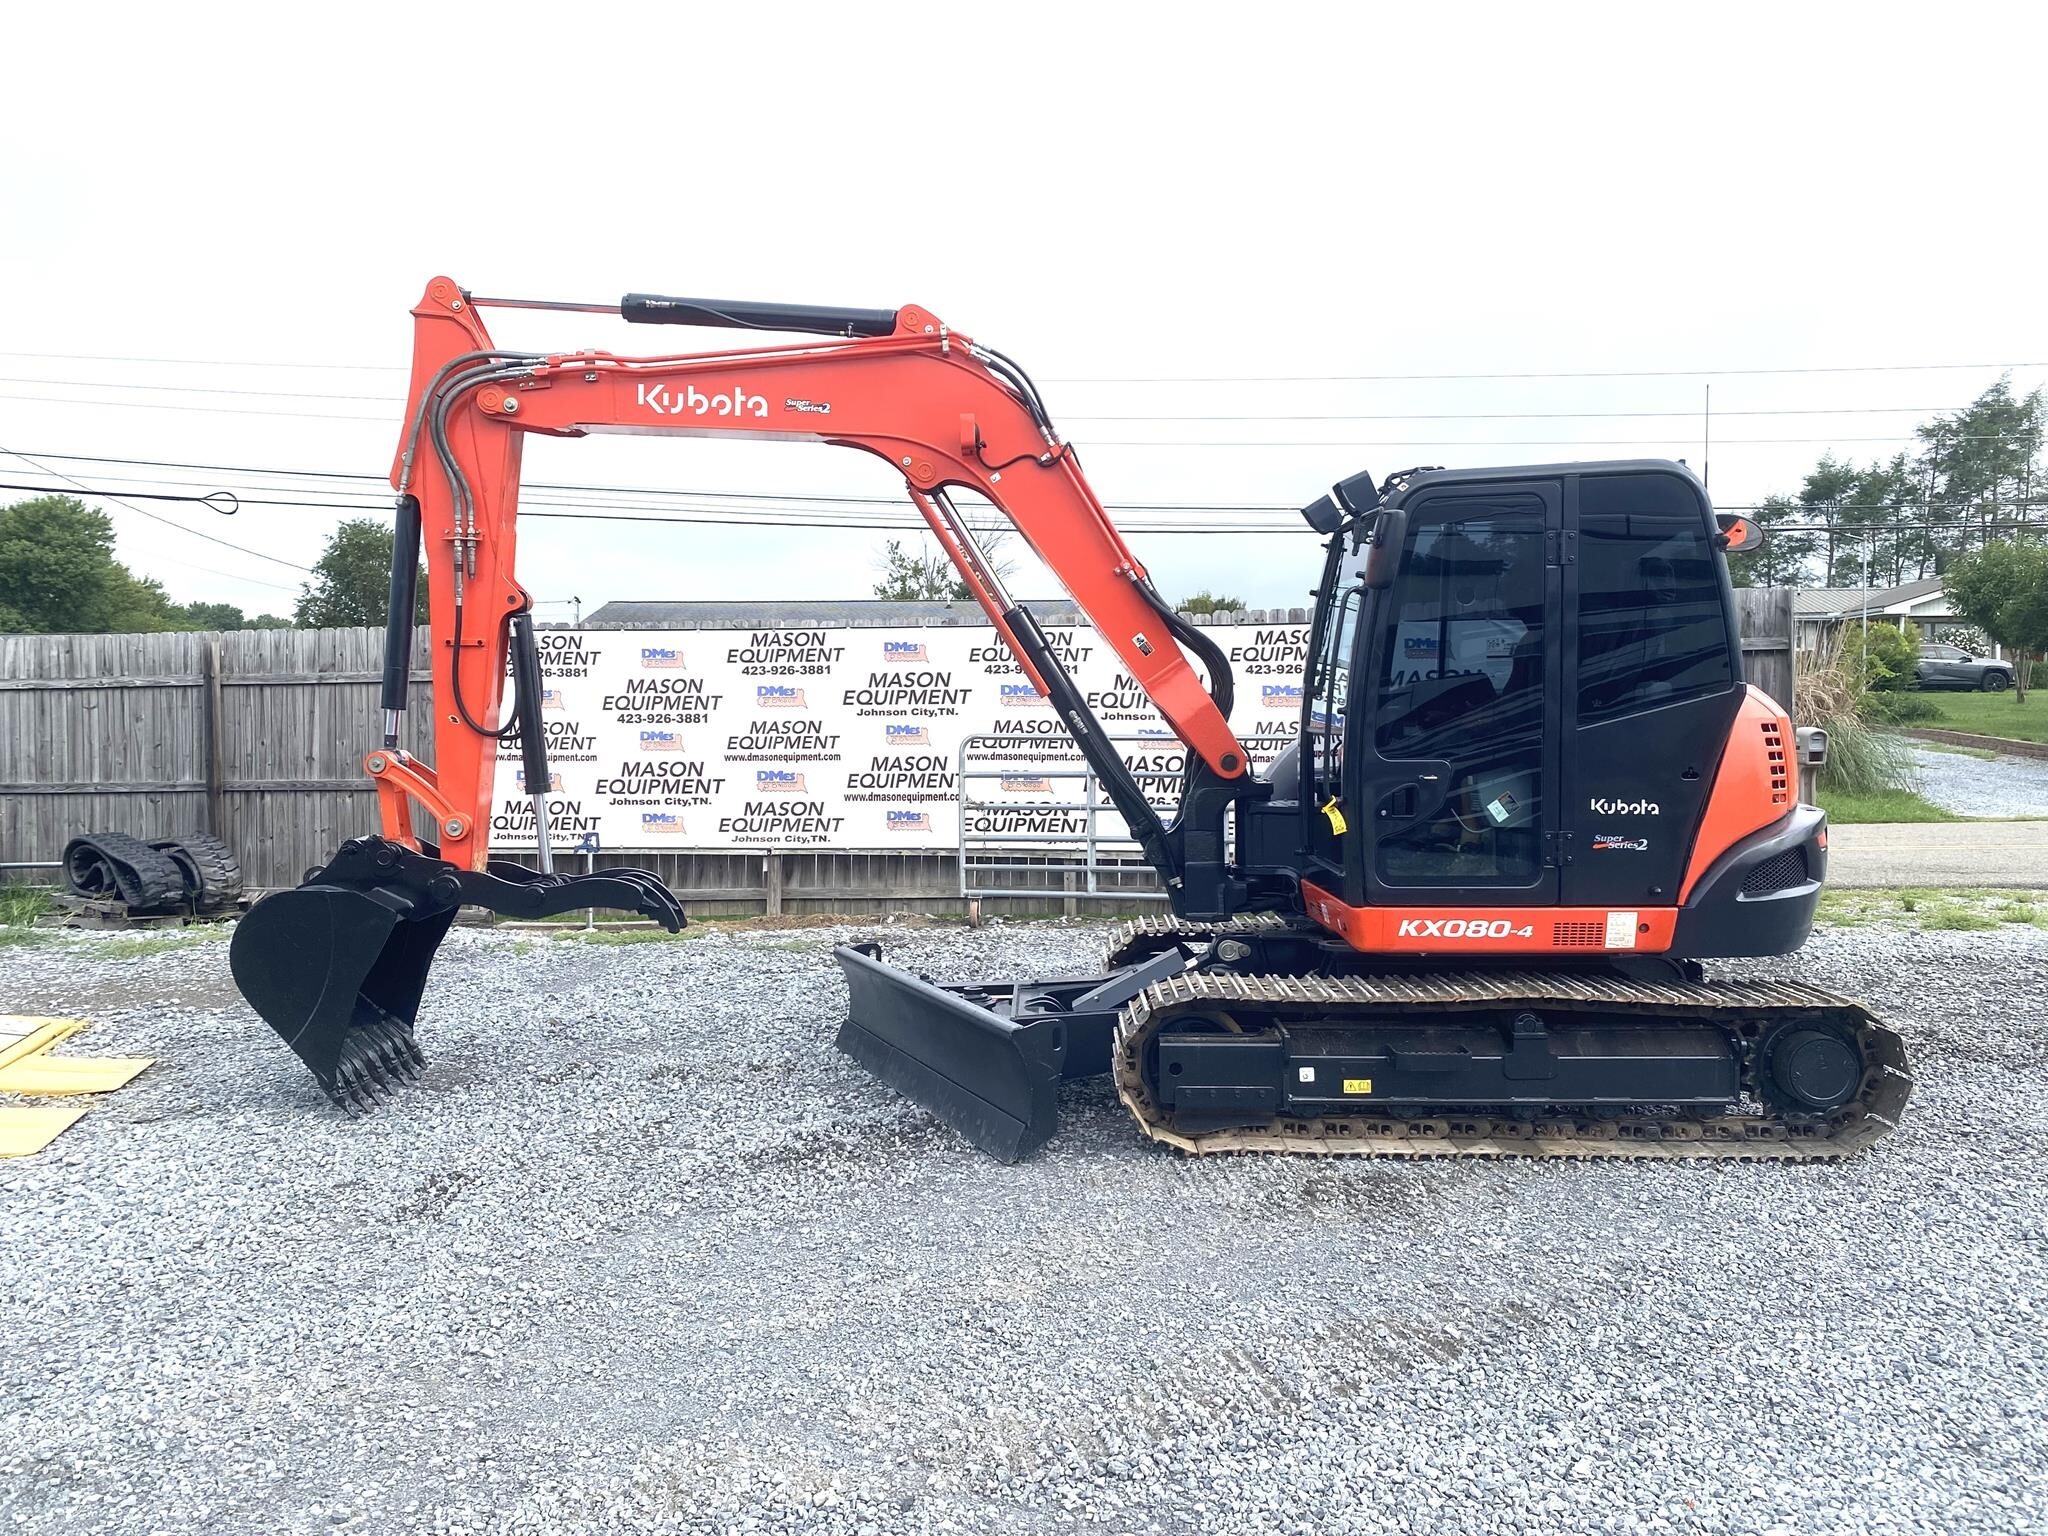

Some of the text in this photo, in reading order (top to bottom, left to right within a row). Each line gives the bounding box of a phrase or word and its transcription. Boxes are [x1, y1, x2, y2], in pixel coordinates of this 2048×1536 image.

[637, 383, 768, 417] Kubota
[750, 632, 826, 647] MASON
[1255, 630, 1310, 645] MASO
[727, 648, 845, 663] EQUIPMENT
[1230, 647, 1307, 662] EQUIPM
[742, 665, 831, 675] 423-926-3881
[1245, 665, 1304, 675] 423-926-
[626, 679, 703, 694] MASON
[868, 672, 951, 687] MASON
[1000, 685, 1038, 695] DMe
[602, 696, 722, 711] EQUIPMENT
[843, 689, 972, 706] EQUIPMENT
[617, 714, 708, 723] 423-926-3881
[856, 708, 907, 716] Johnson
[1101, 712, 1155, 721] Johnson
[750, 721, 822, 735] MASON
[993, 720, 1068, 734] MASON
[1255, 721, 1299, 735] MAS
[727, 736, 840, 750] EQUIPMENT
[970, 738, 1075, 749] EQUIPMEN
[724, 752, 841, 763] www.dmasonequipment.com
[871, 756, 947, 772] MASON
[621, 762, 704, 777] MASON
[595, 779, 725, 794] EQUIPMENT
[609, 798, 659, 806] Johnson
[843, 792, 960, 803] www.dmasonequipment.co
[504, 801, 581, 815] MAON
[743, 802, 824, 816] MASON
[1591, 798, 1659, 815] Kubota
[489, 816, 601, 831] QUIPMENT
[718, 818, 844, 833] EQUIPMENT
[1594, 834, 1624, 843] Super
[1398, 919, 1534, 938] KX080-4
